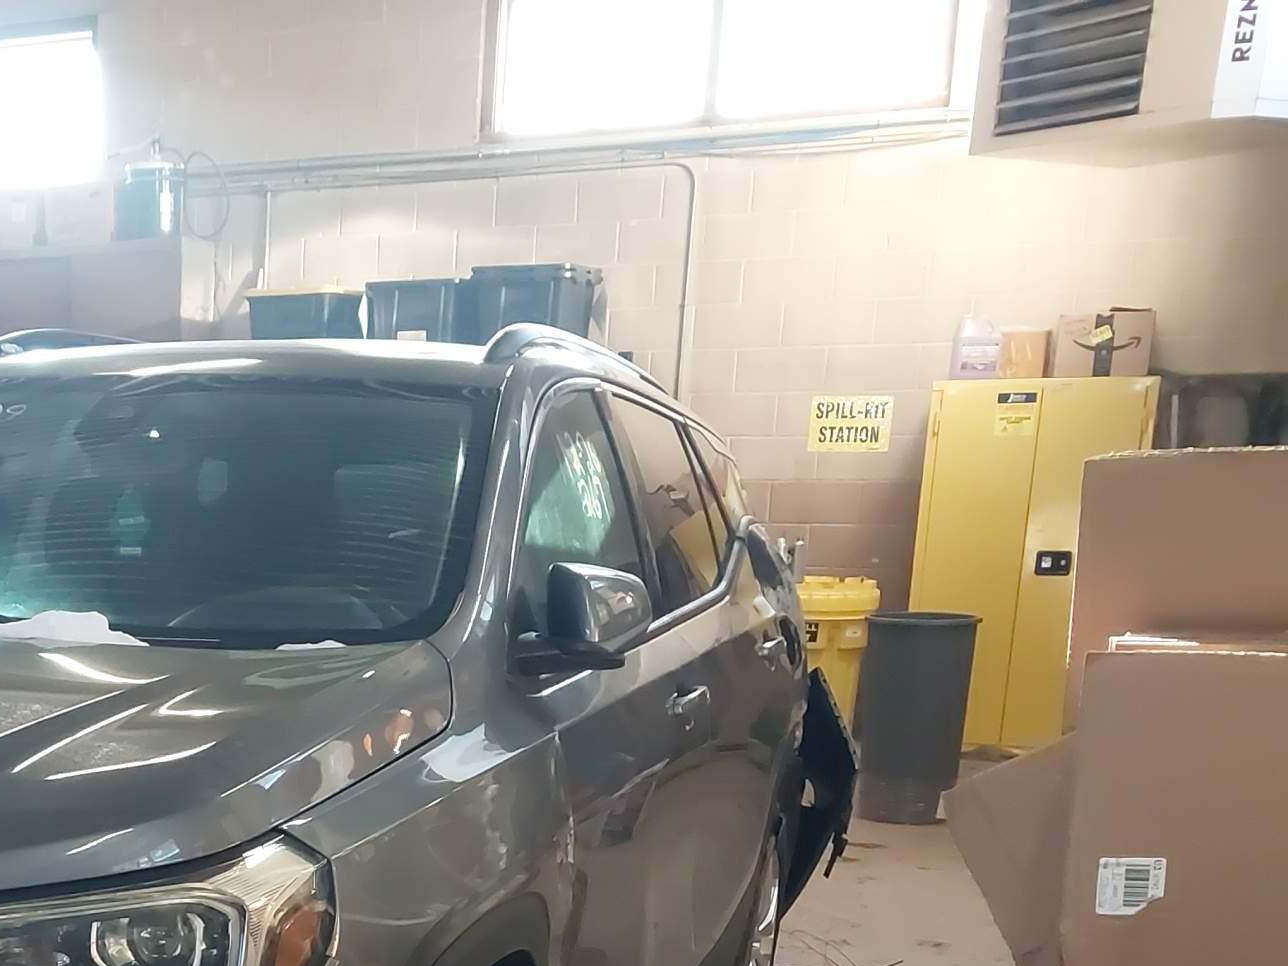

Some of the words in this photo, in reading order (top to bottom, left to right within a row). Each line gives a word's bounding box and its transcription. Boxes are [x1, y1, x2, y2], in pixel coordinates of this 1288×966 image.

[1231, 0, 1258, 62] REZN
[815, 401, 889, 420] SPILL-KIT
[818, 425, 880, 443] STATION
